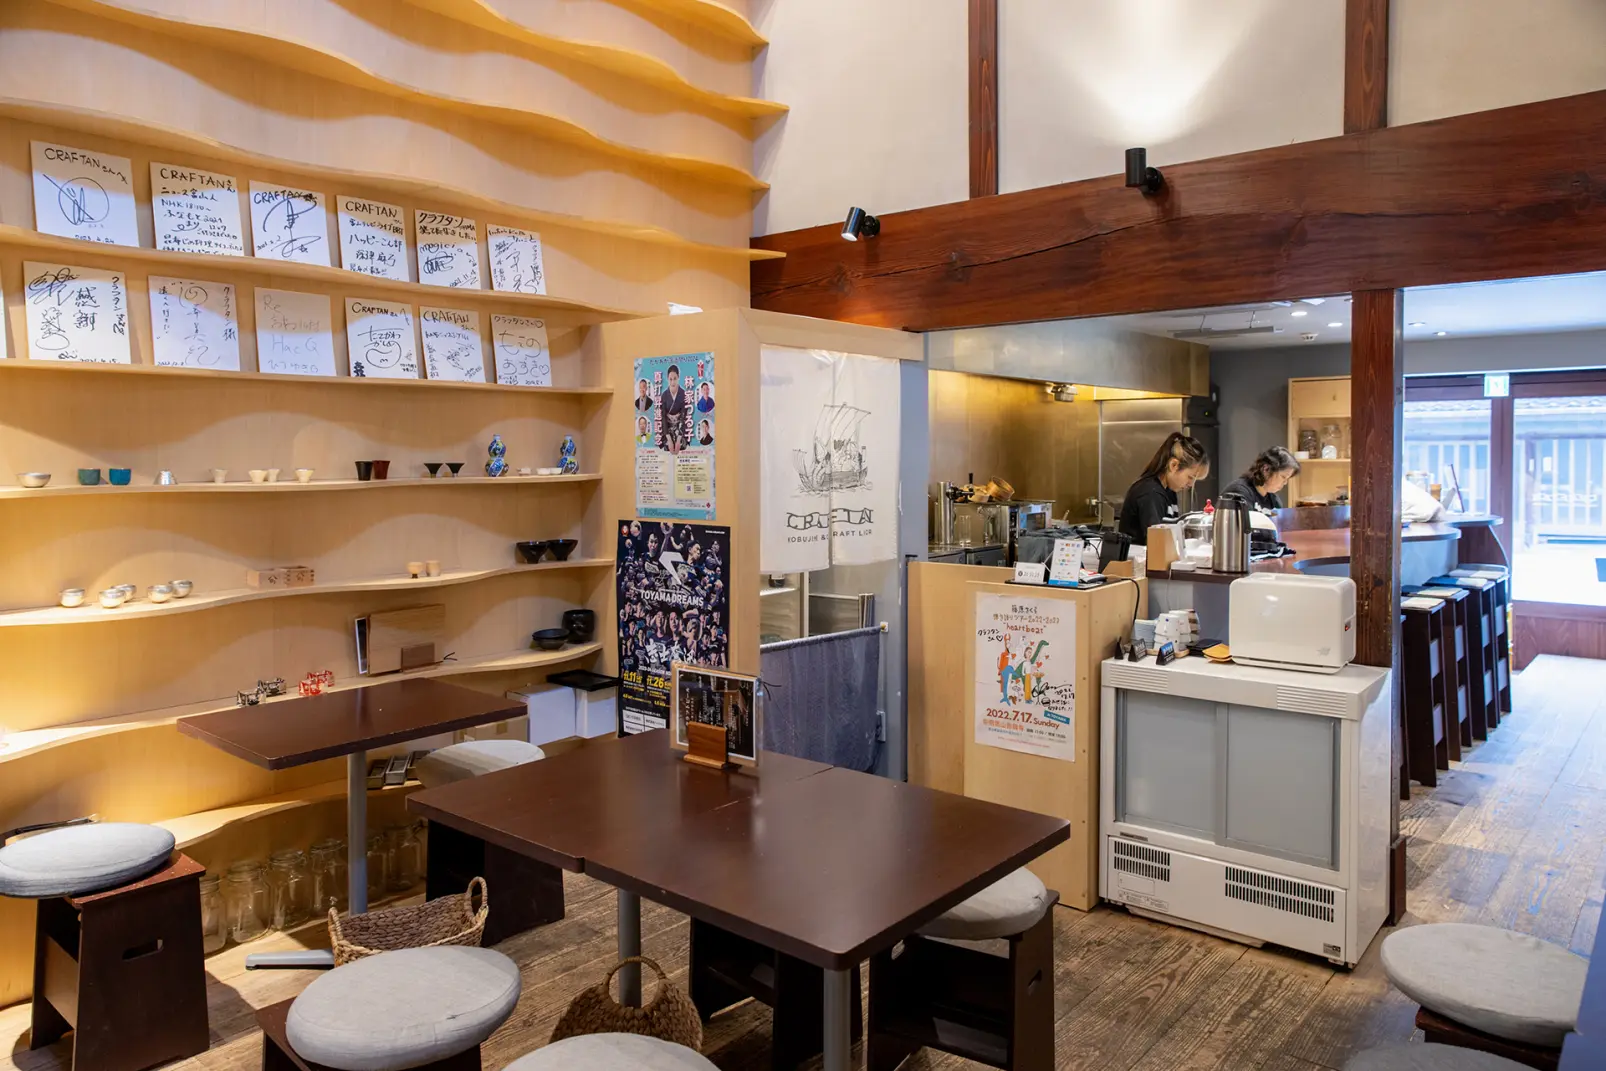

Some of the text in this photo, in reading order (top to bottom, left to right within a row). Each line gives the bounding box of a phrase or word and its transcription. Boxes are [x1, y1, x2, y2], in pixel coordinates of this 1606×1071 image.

[345, 200, 398, 218] CRAFTAN
[653, 371, 663, 446] 真打昇進記念
[684, 375, 694, 443] 林家つる子
[1033, 717, 1060, 730] Sunday
